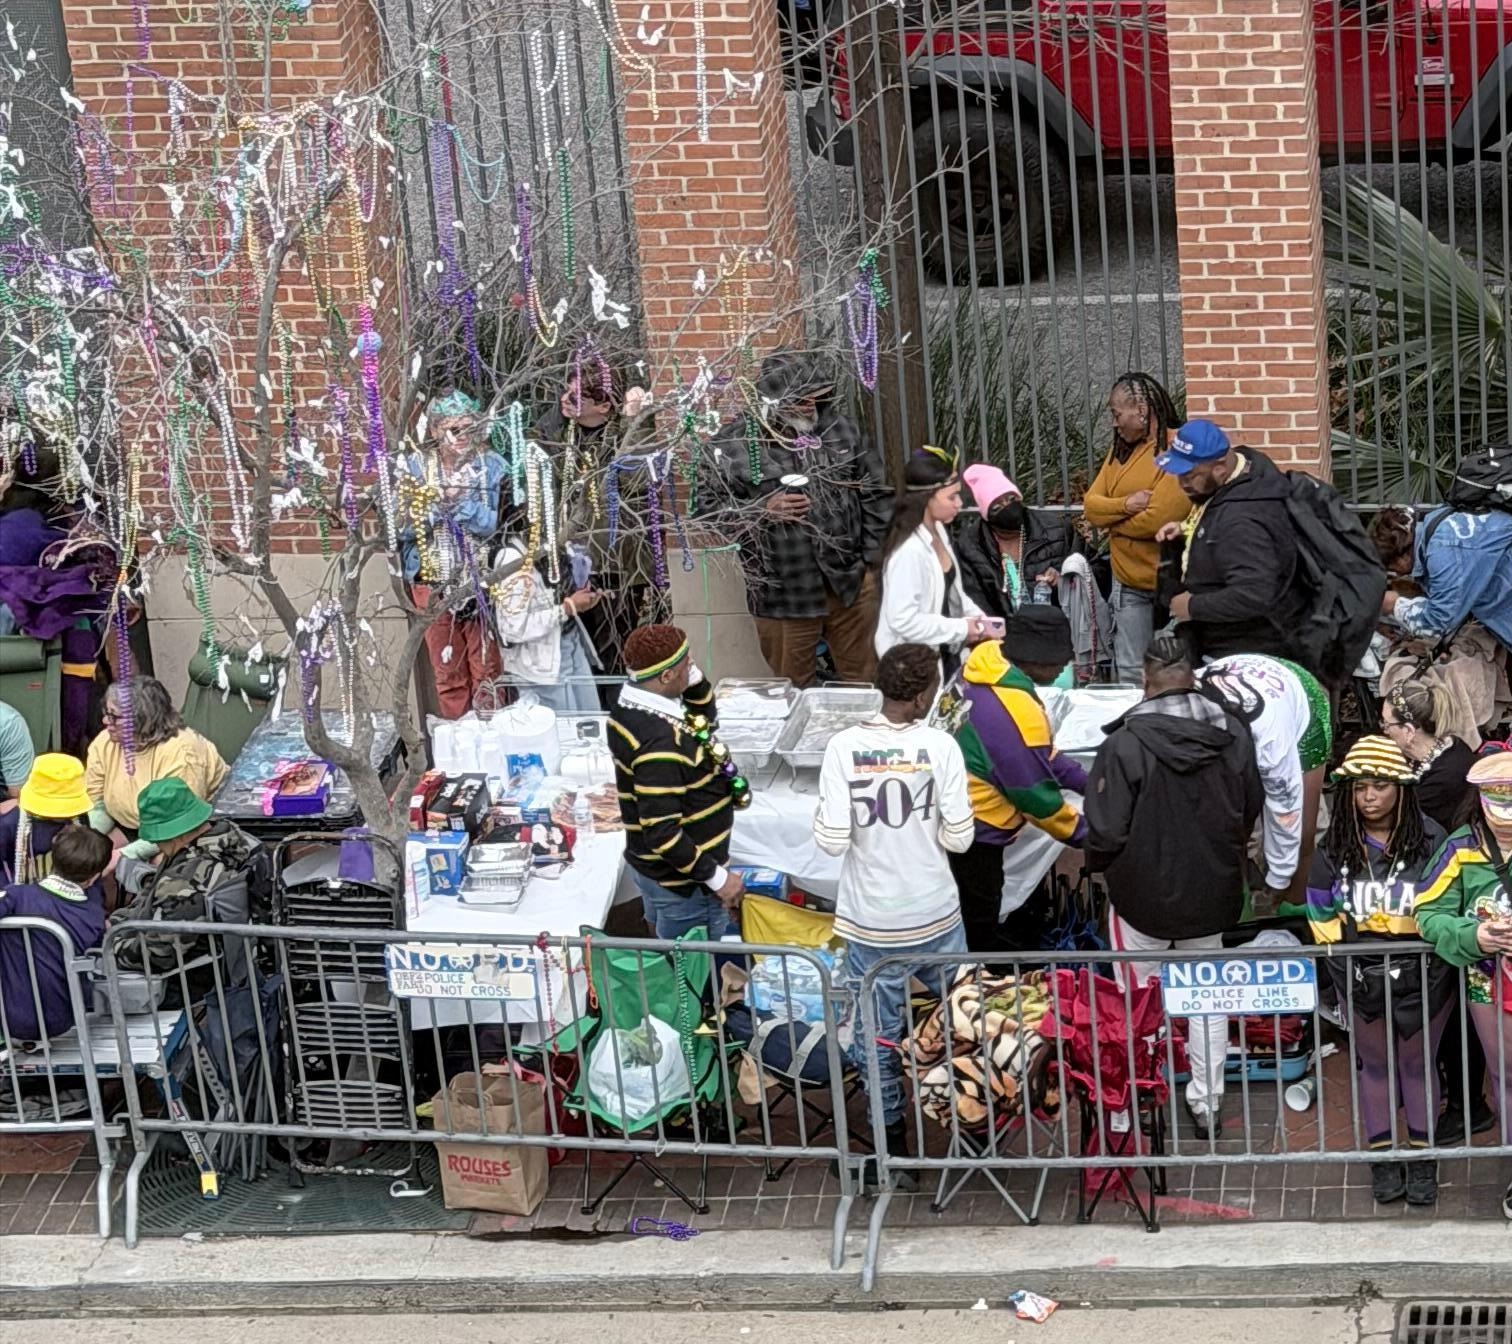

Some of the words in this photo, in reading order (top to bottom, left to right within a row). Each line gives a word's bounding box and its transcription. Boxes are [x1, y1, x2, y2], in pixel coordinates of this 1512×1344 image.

[848, 777, 936, 829] 504
[1352, 881, 1415, 916] NOLA
[425, 974, 466, 984] POLICE
[1168, 961, 1221, 987] N.O.
[1256, 960, 1308, 984] P.D.
[440, 985, 463, 995] NOT
[471, 986, 511, 997] CROSS
[1191, 988, 1245, 999] POLICE
[1257, 986, 1289, 998] LINE
[1181, 1001, 1201, 1011] DO
[1213, 999, 1243, 1010] NOT
[1251, 997, 1300, 1009] CROSS
[447, 1154, 512, 1177] ROUSES
